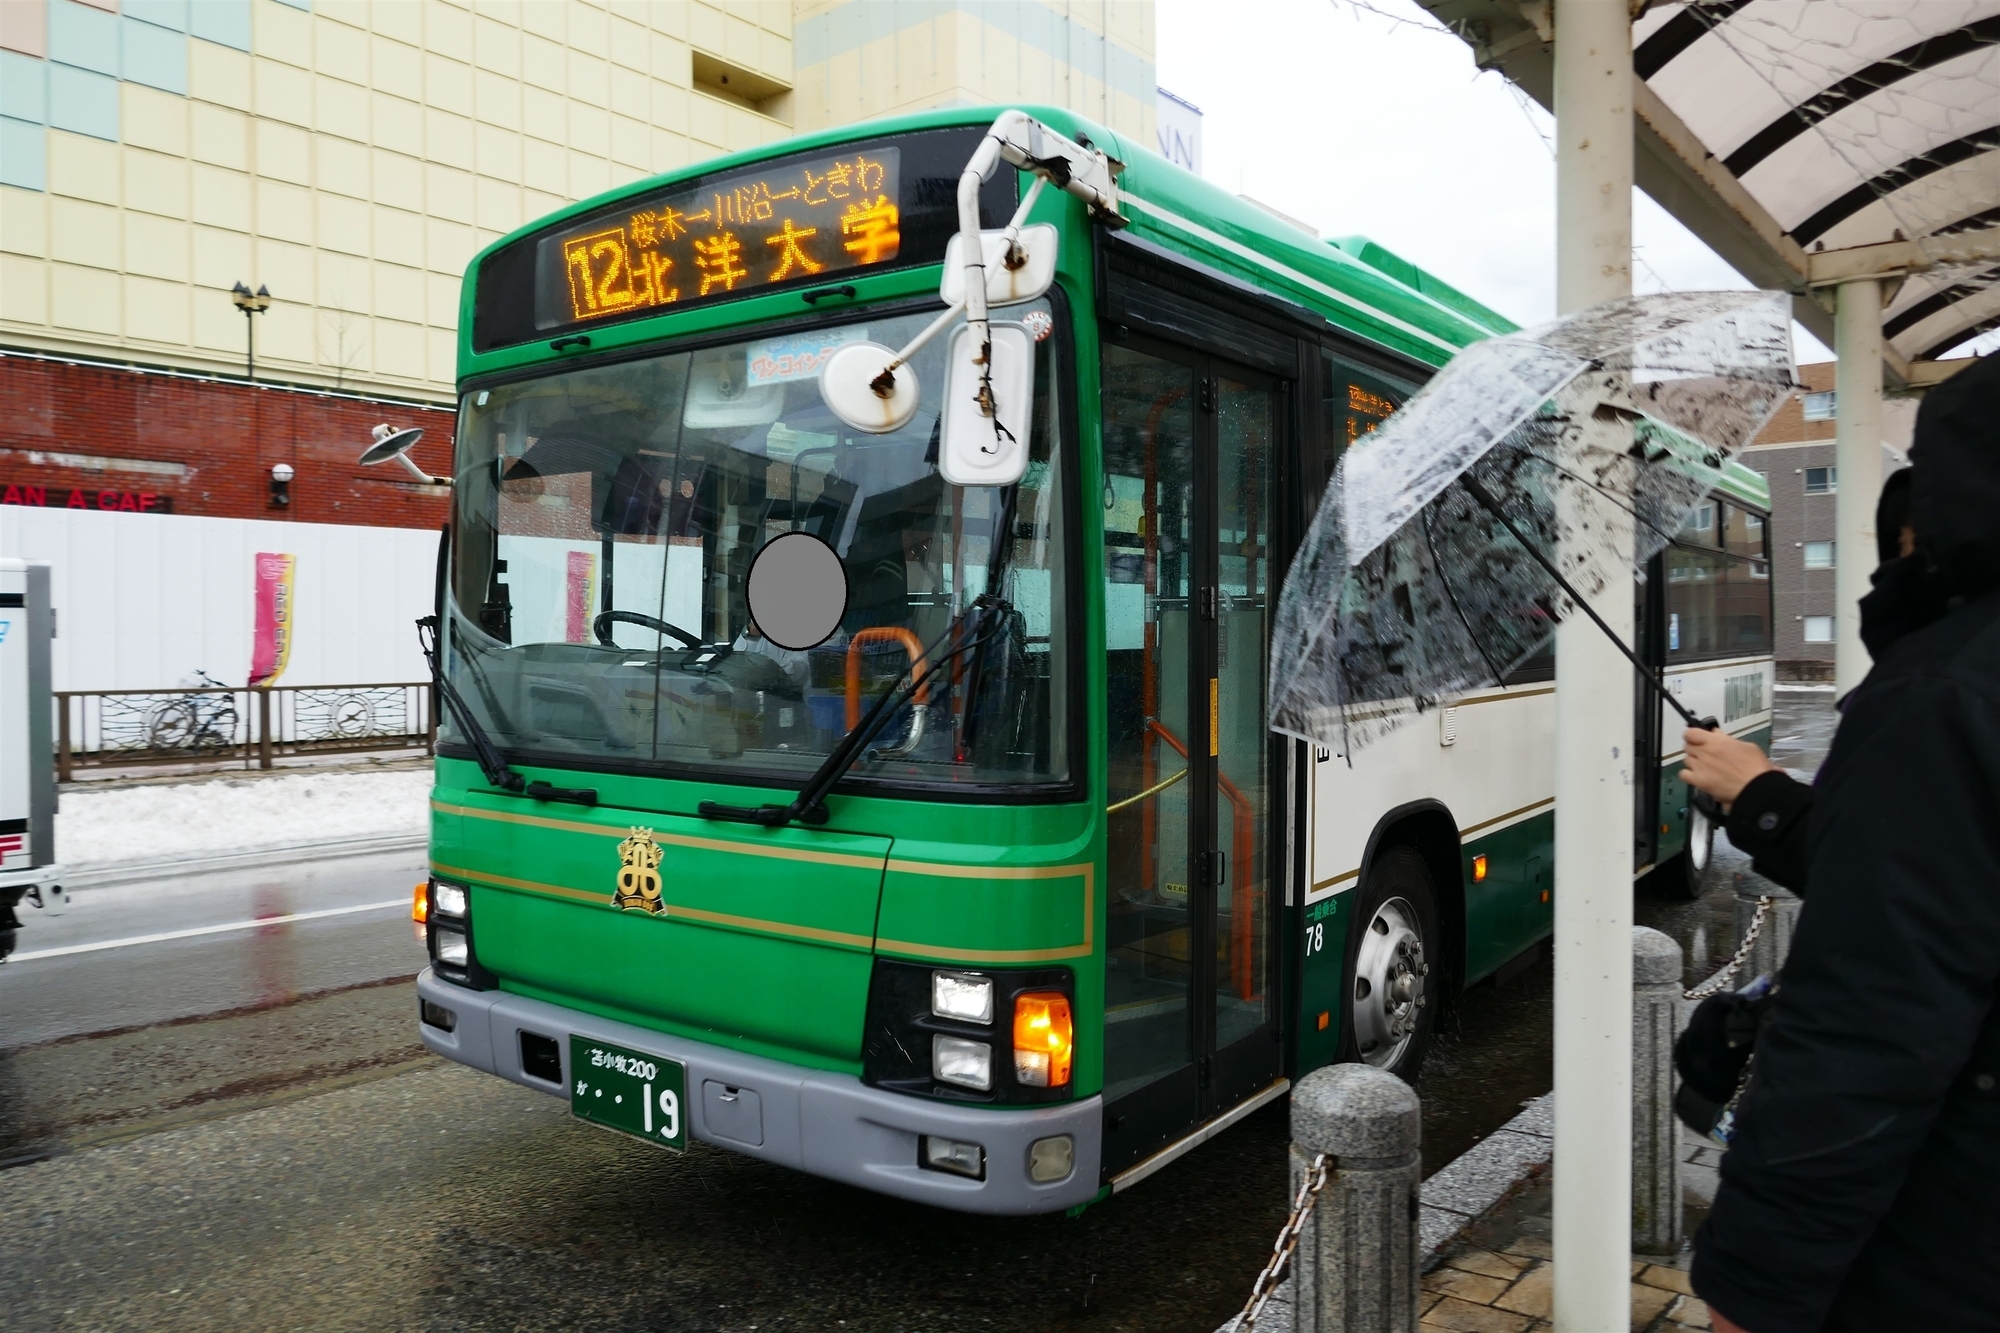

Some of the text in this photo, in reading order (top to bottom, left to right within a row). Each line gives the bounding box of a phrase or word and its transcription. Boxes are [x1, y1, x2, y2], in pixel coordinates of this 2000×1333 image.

[804, 156, 884, 205] ときわ
[568, 194, 901, 310] 12 北洋大学
[1305, 922, 1324, 957] 78
[643, 1082, 679, 1139] 19
